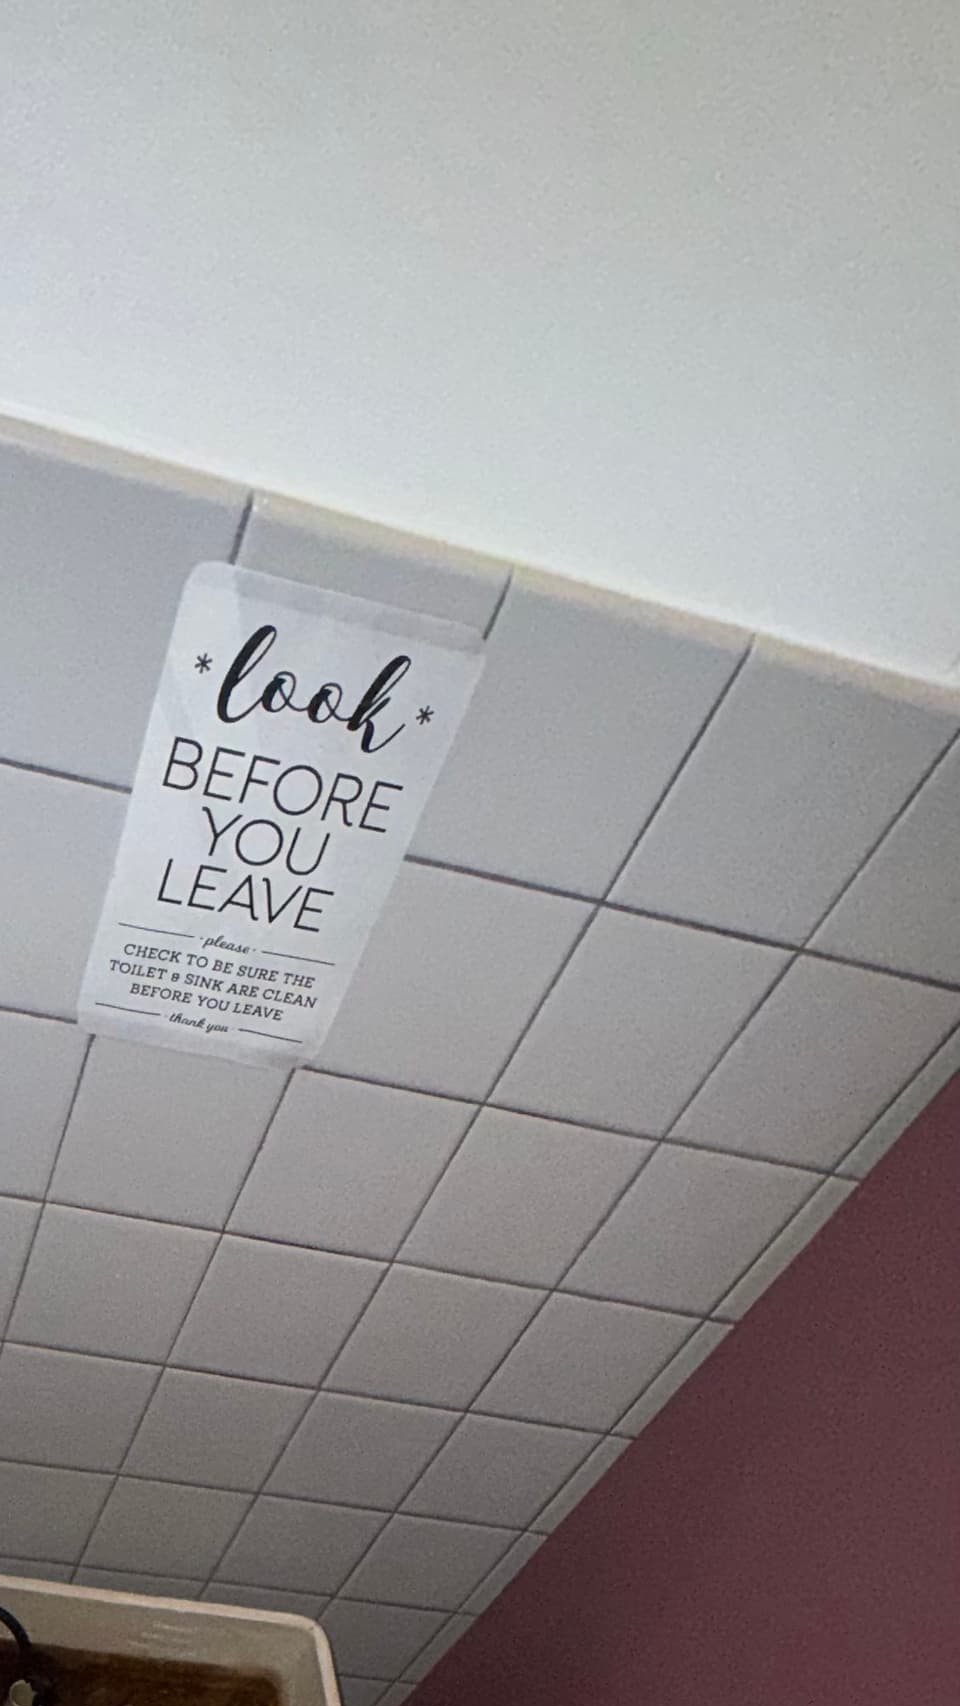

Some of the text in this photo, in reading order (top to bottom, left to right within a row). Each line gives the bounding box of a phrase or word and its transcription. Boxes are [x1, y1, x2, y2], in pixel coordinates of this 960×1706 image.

[217, 624, 411, 752] look
[162, 736, 403, 832] BEFORE
[202, 806, 330, 875] YOU
[157, 859, 334, 931] LEAVE
[123, 943, 316, 989] CHECK TO BE SURE THE
[202, 935, 250, 955] please
[109, 959, 167, 980] TOILET
[184, 973, 224, 992] SINK
[226, 982, 259, 998] ARE
[262, 989, 318, 1009] CLEAN
[129, 983, 283, 1021] BEFORE YOU LEAVE
[169, 1012, 229, 1034] thank you
